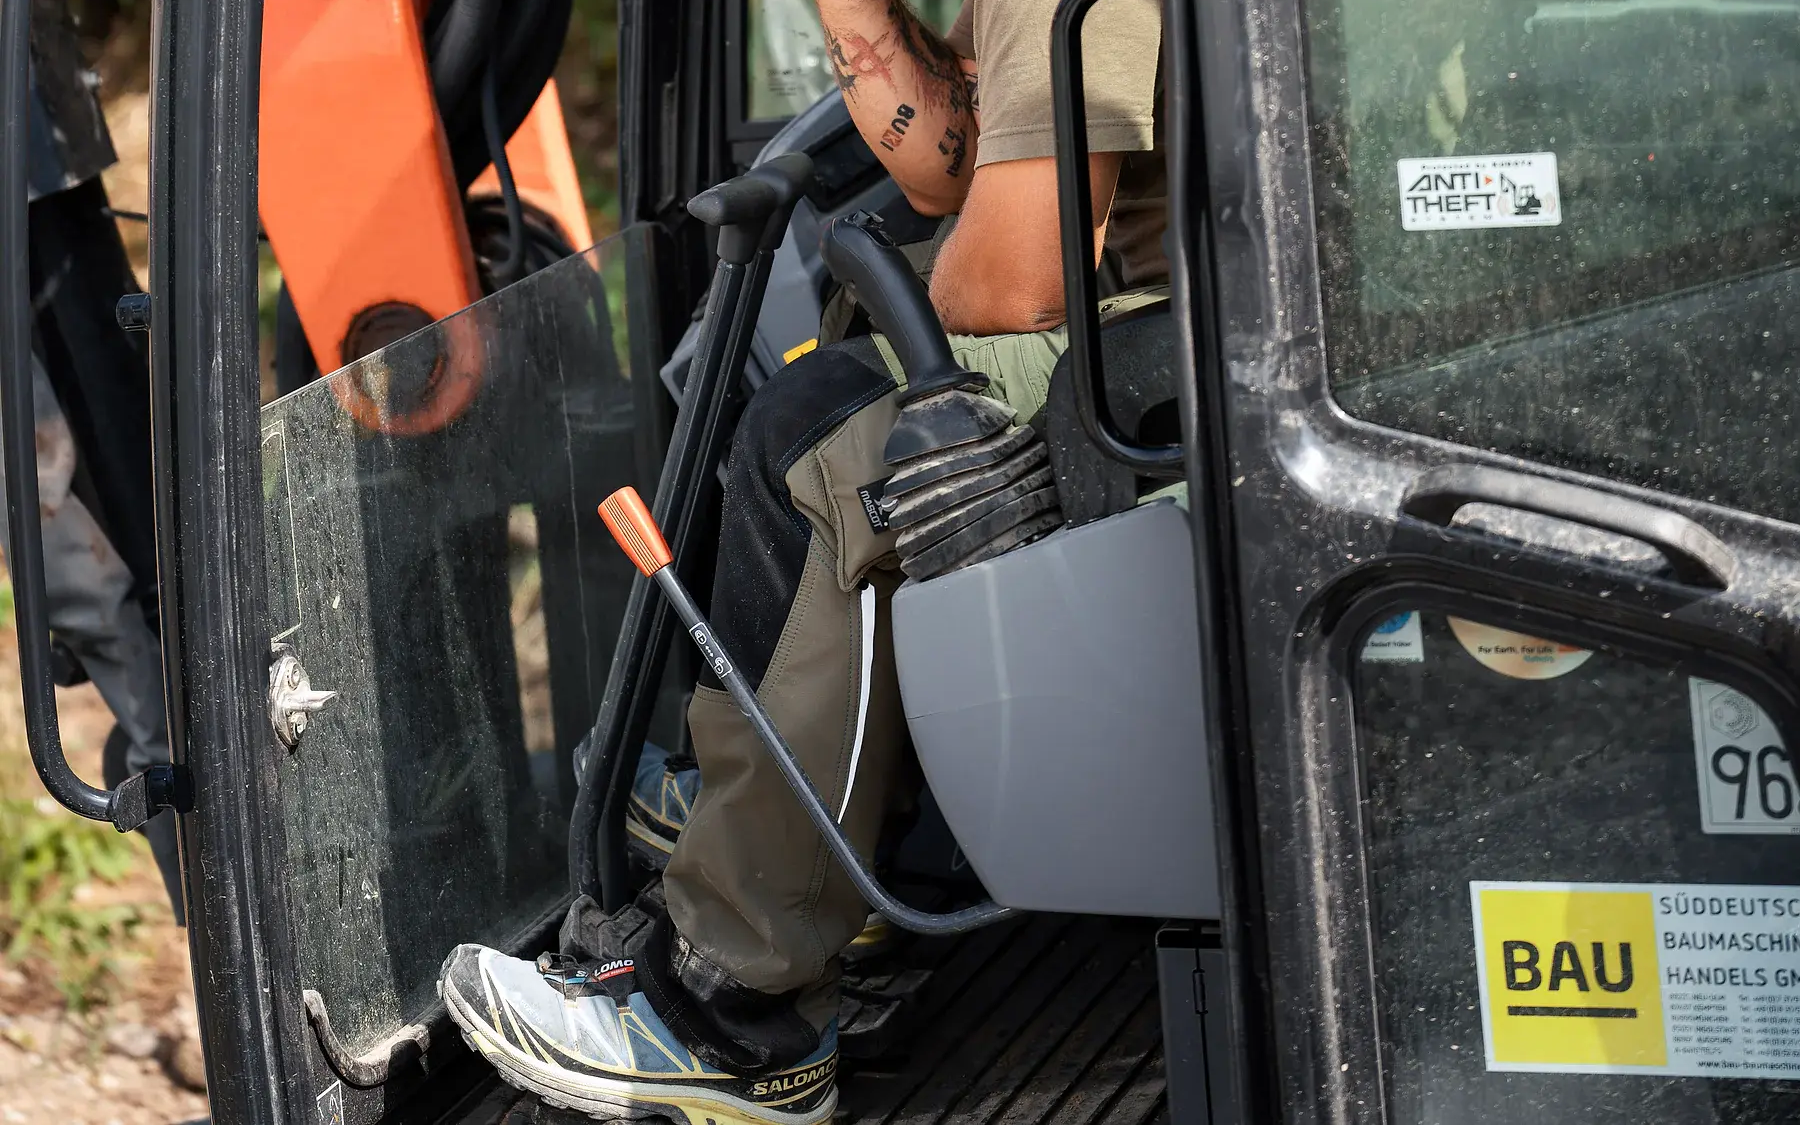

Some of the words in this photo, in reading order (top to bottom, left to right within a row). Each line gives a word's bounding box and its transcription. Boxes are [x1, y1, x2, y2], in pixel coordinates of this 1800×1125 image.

[1408, 172, 1480, 192] ANTI
[1406, 193, 1496, 214] THEFT
[860, 489, 883, 527] MASCOT
[1711, 744, 1800, 820] 96
[576, 959, 634, 978] SLOMO
[1503, 940, 1634, 994] BAU
[1667, 966, 1768, 987] HANDELS
